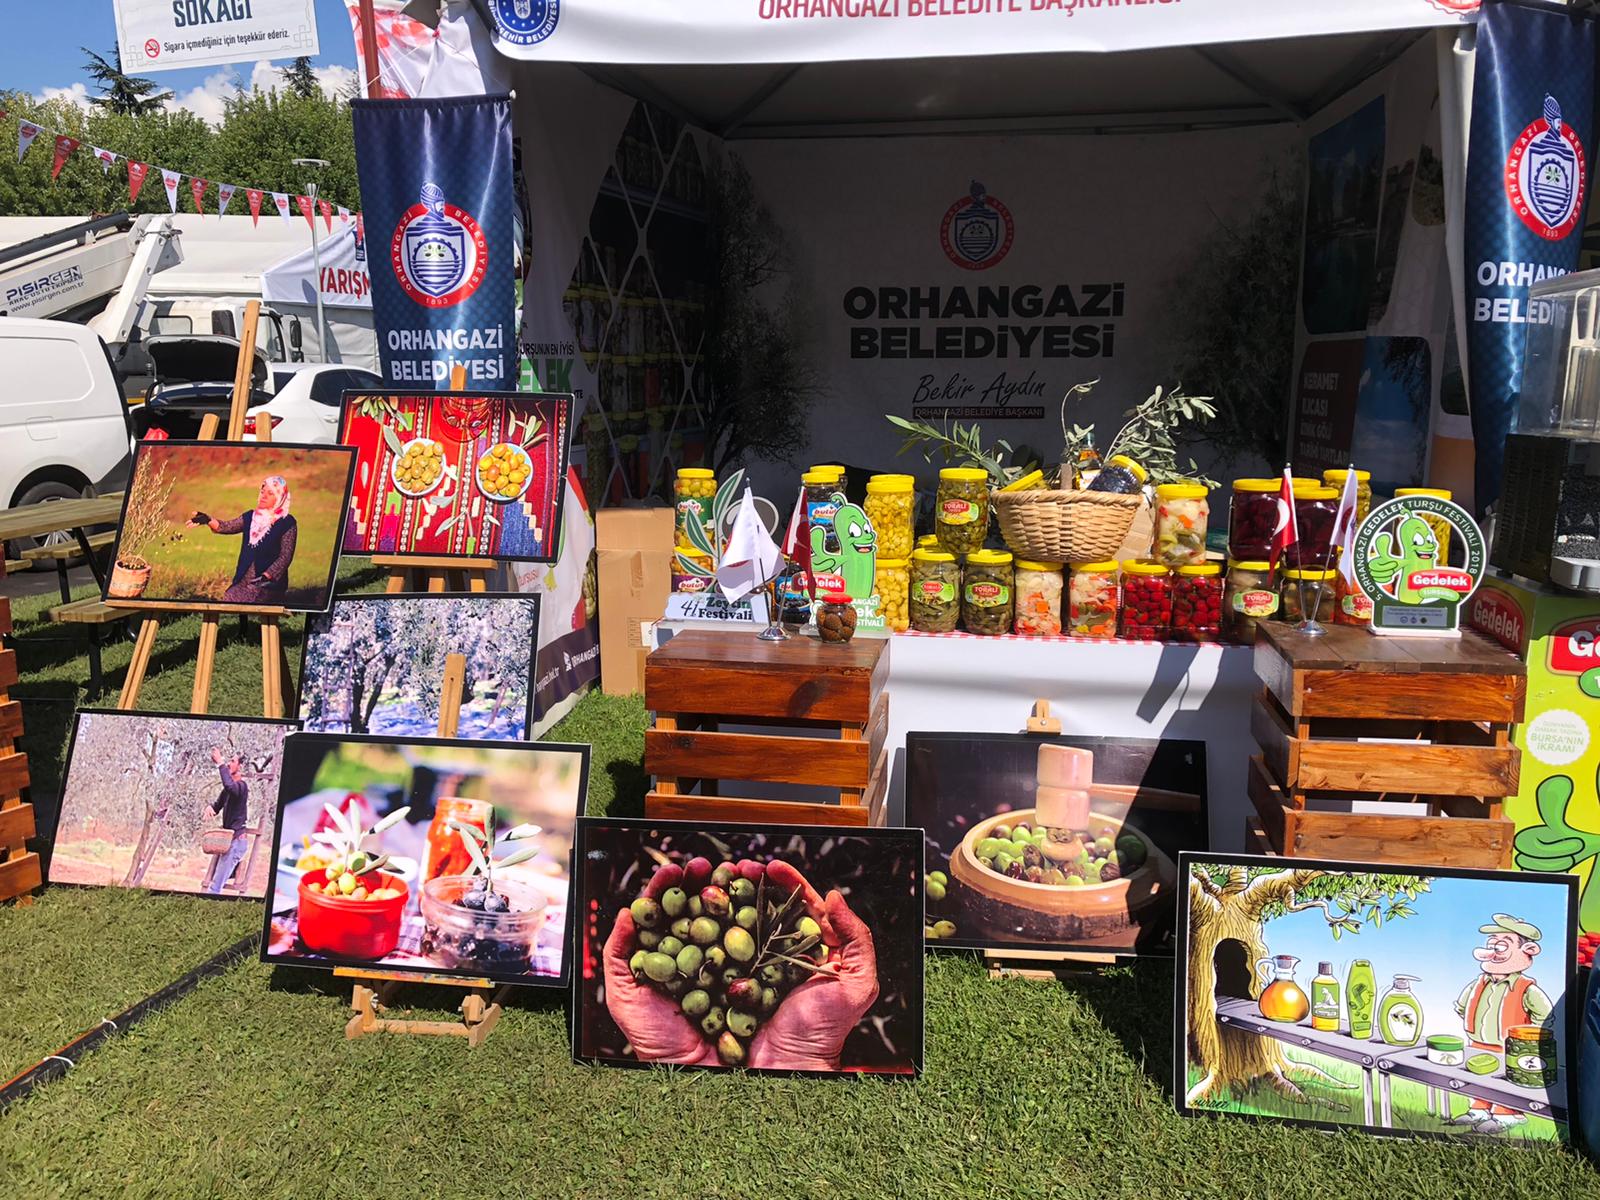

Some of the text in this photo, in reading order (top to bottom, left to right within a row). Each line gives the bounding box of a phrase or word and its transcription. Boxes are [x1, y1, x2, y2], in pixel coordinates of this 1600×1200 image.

[164, 41, 185, 53] Sigara
[223, 36, 236, 46] için
[237, 31, 266, 44] teşekkür
[843, 282, 1125, 319] ORHANGAZİ
[388, 324, 503, 350] ORHANGAZİ
[850, 324, 1115, 359] BELEDİYESİ
[912, 370, 1046, 406] Bekir Aydın
[1363, 502, 1405, 536] GEDELEK
[1407, 500, 1443, 511] TURŞU
[1357, 536, 1376, 593] ORHANGAZİ
[1469, 550, 1480, 574] 2018
[1412, 574, 1468, 587] Gedelek
[698, 608, 752, 620] Festivali
[1474, 599, 1520, 644] Gedelek
